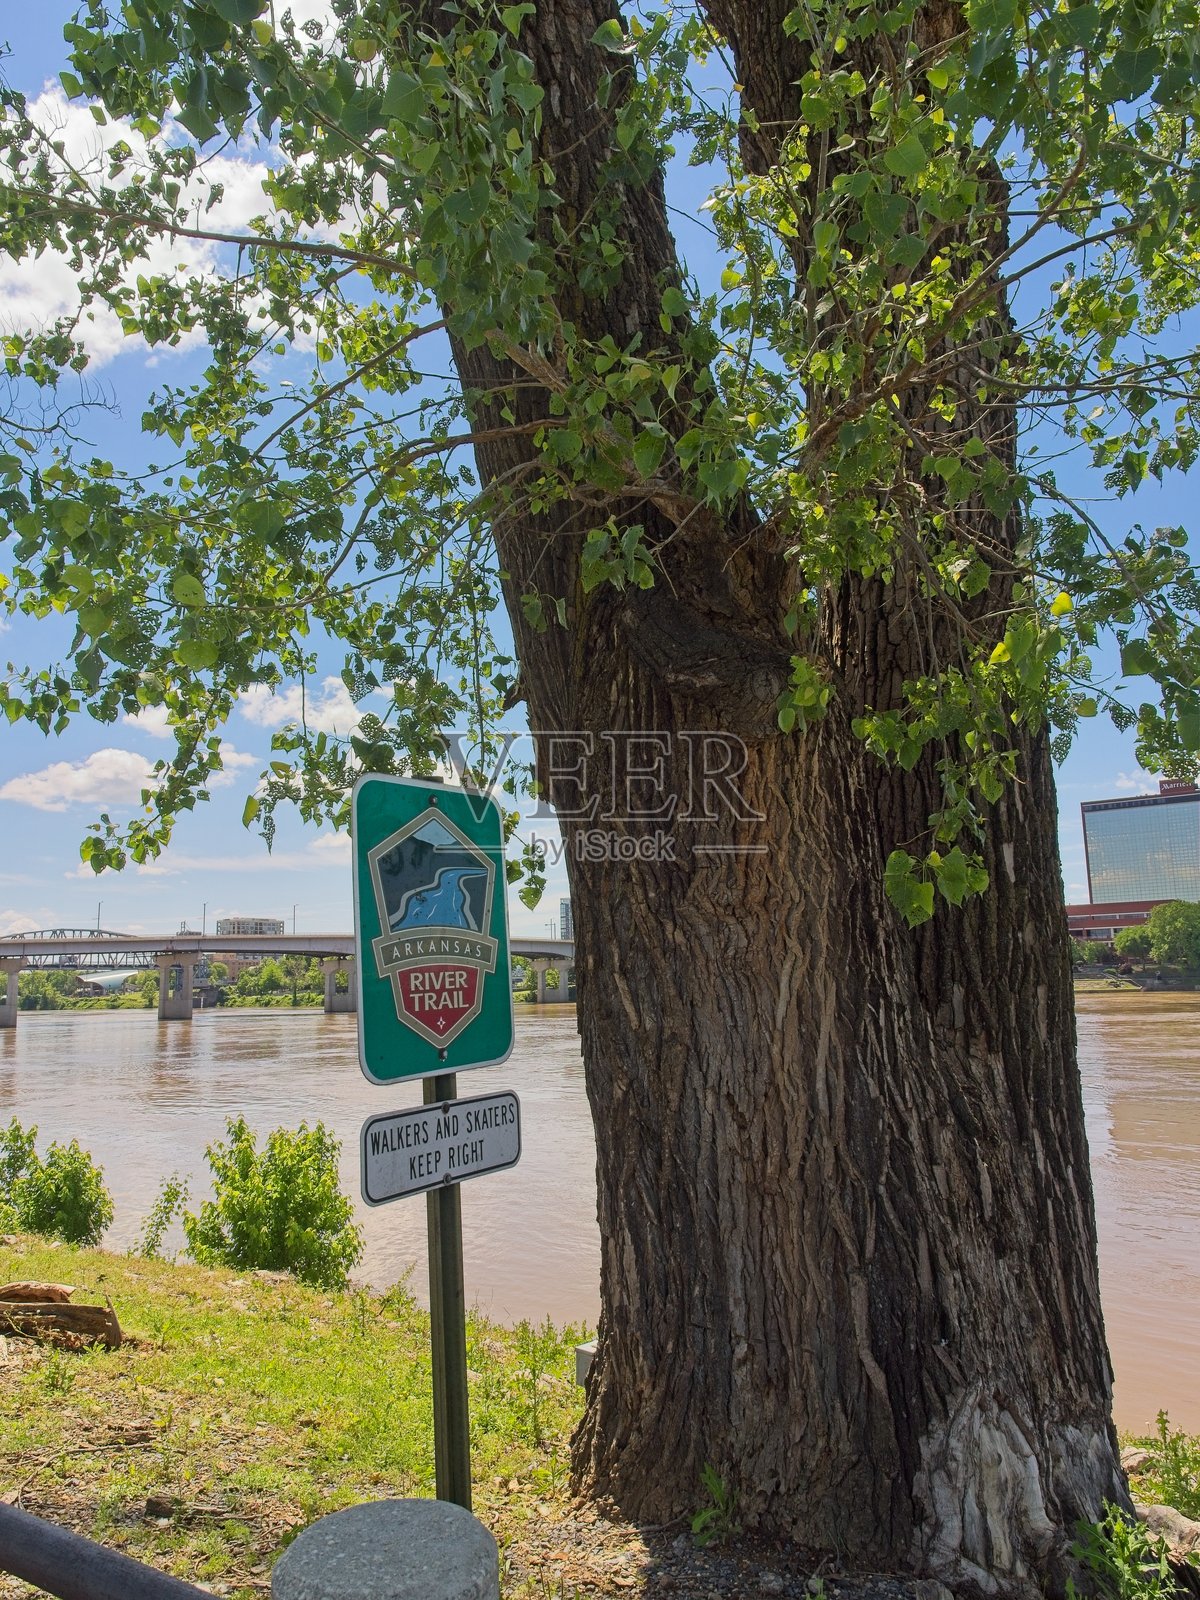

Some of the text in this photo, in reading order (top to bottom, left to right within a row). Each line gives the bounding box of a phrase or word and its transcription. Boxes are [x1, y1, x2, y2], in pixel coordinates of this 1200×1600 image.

[392, 940, 482, 960] ARKANSAS
[410, 970, 468, 991] RIVER
[409, 991, 470, 1012] TRAIL
[370, 1102, 515, 1156] WALKERS AND SKATERS
[409, 1139, 484, 1180] KEEP RIGHT
